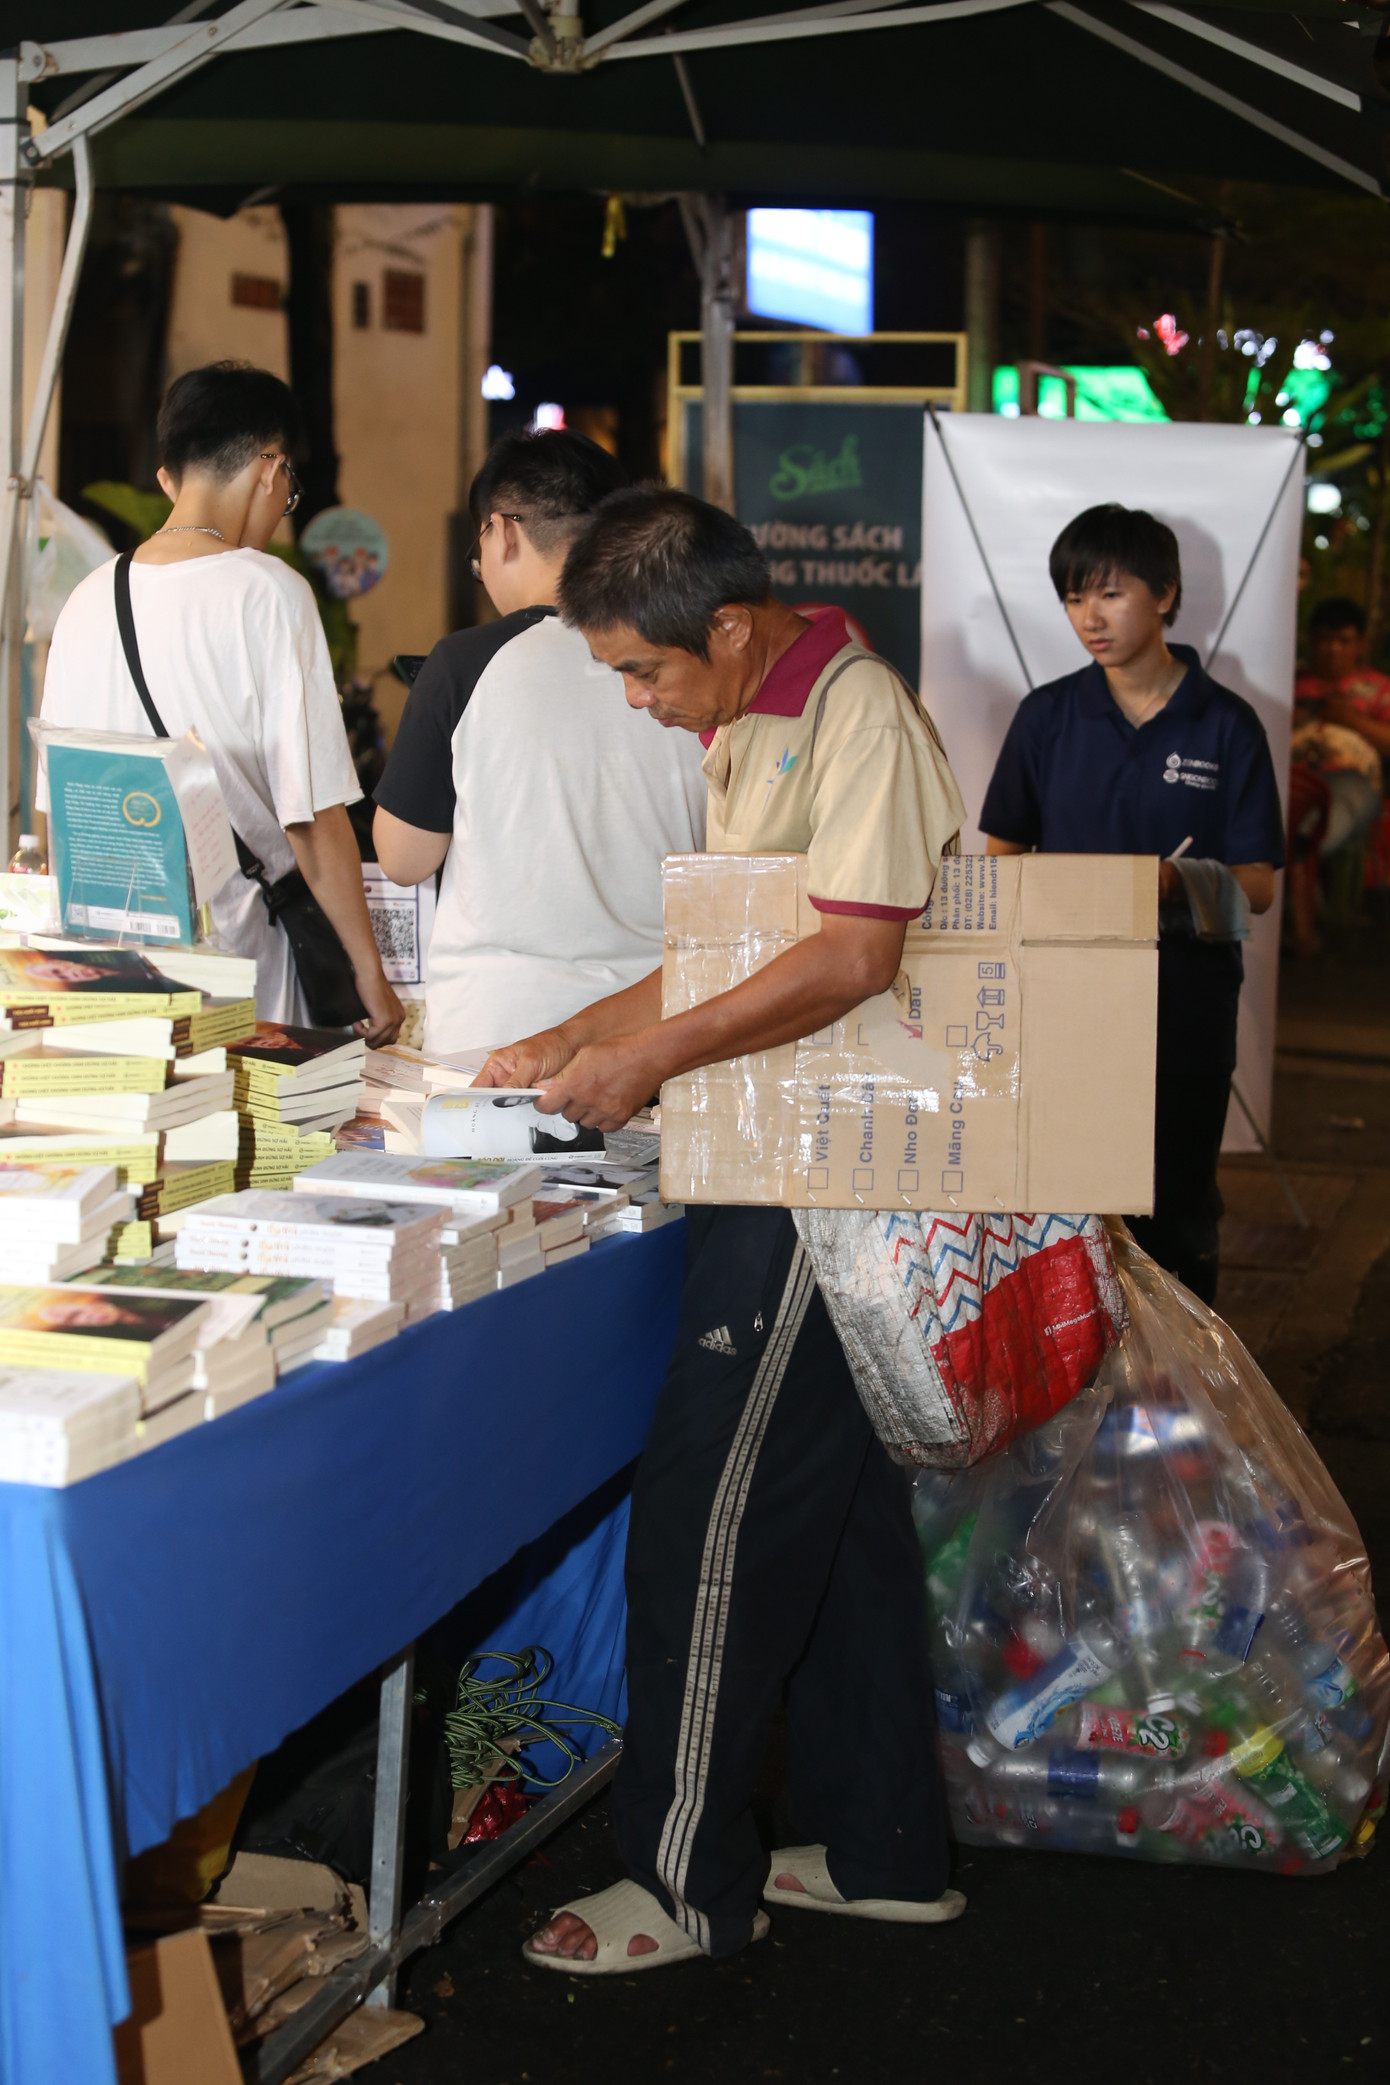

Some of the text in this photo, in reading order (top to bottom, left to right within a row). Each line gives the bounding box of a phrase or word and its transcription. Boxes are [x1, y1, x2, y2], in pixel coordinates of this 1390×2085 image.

[833, 520, 904, 550] SÁCH
[803, 554, 893, 588] THUỐC
[953, 868, 961, 878] 13
[965, 889, 973, 912] (028)
[977, 891, 985, 930] Website:
[989, 901, 997, 930] Email:
[815, 1130, 832, 1162] Việt
[904, 1131, 918, 1164] Nho
[698, 1337, 738, 1356] adidas
[1138, 1713, 1176, 1751] C2
